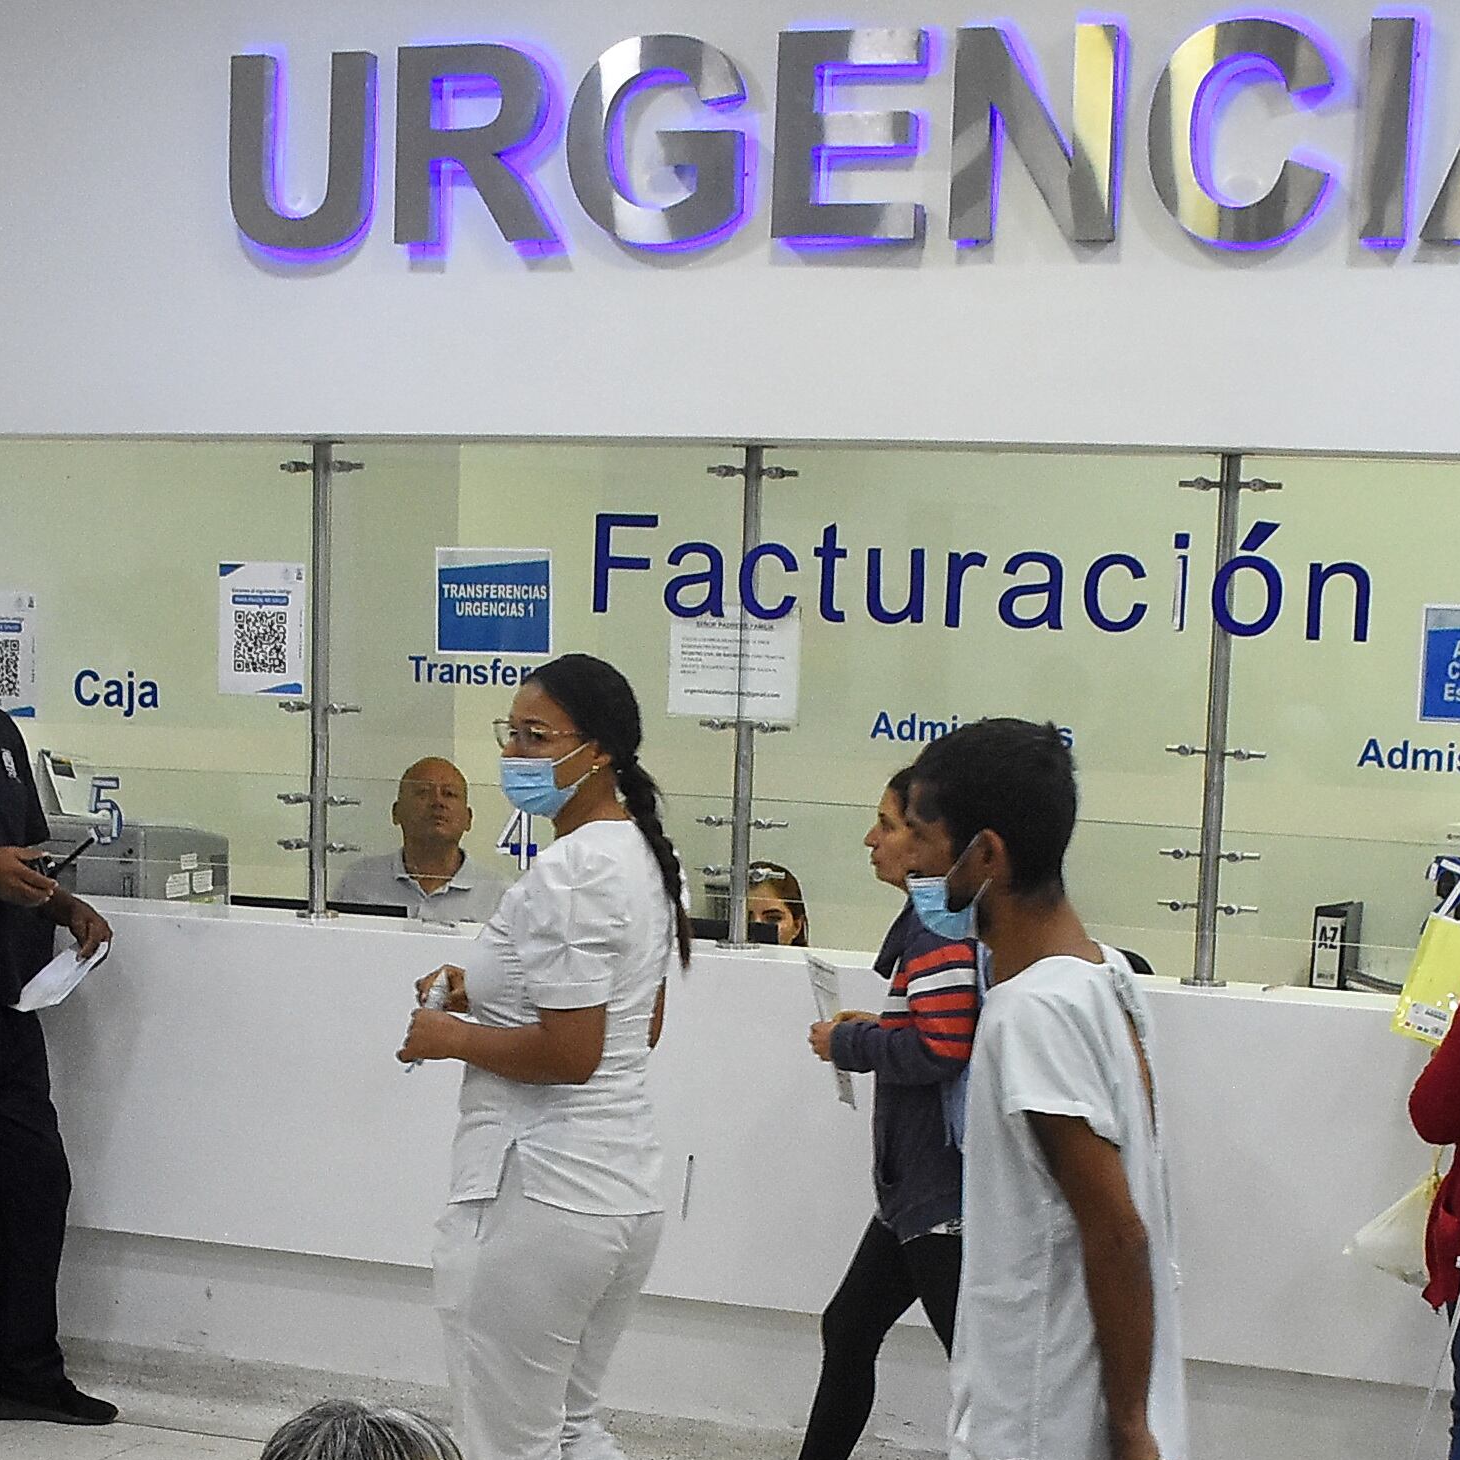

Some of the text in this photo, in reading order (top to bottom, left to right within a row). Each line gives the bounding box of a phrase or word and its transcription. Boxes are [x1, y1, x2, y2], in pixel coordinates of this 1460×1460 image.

[442, 583, 547, 600] TRANSFERENCIAS
[592, 513, 1372, 643] Facturación
[456, 601, 535, 618] URGENCIAS 1
[408, 655, 533, 686] Transfer
[74, 670, 159, 717] Caja
[871, 711, 1073, 749] Admis
[90, 777, 124, 845] 5
[496, 809, 538, 871] 4
[1318, 926, 1339, 949] A-Z
